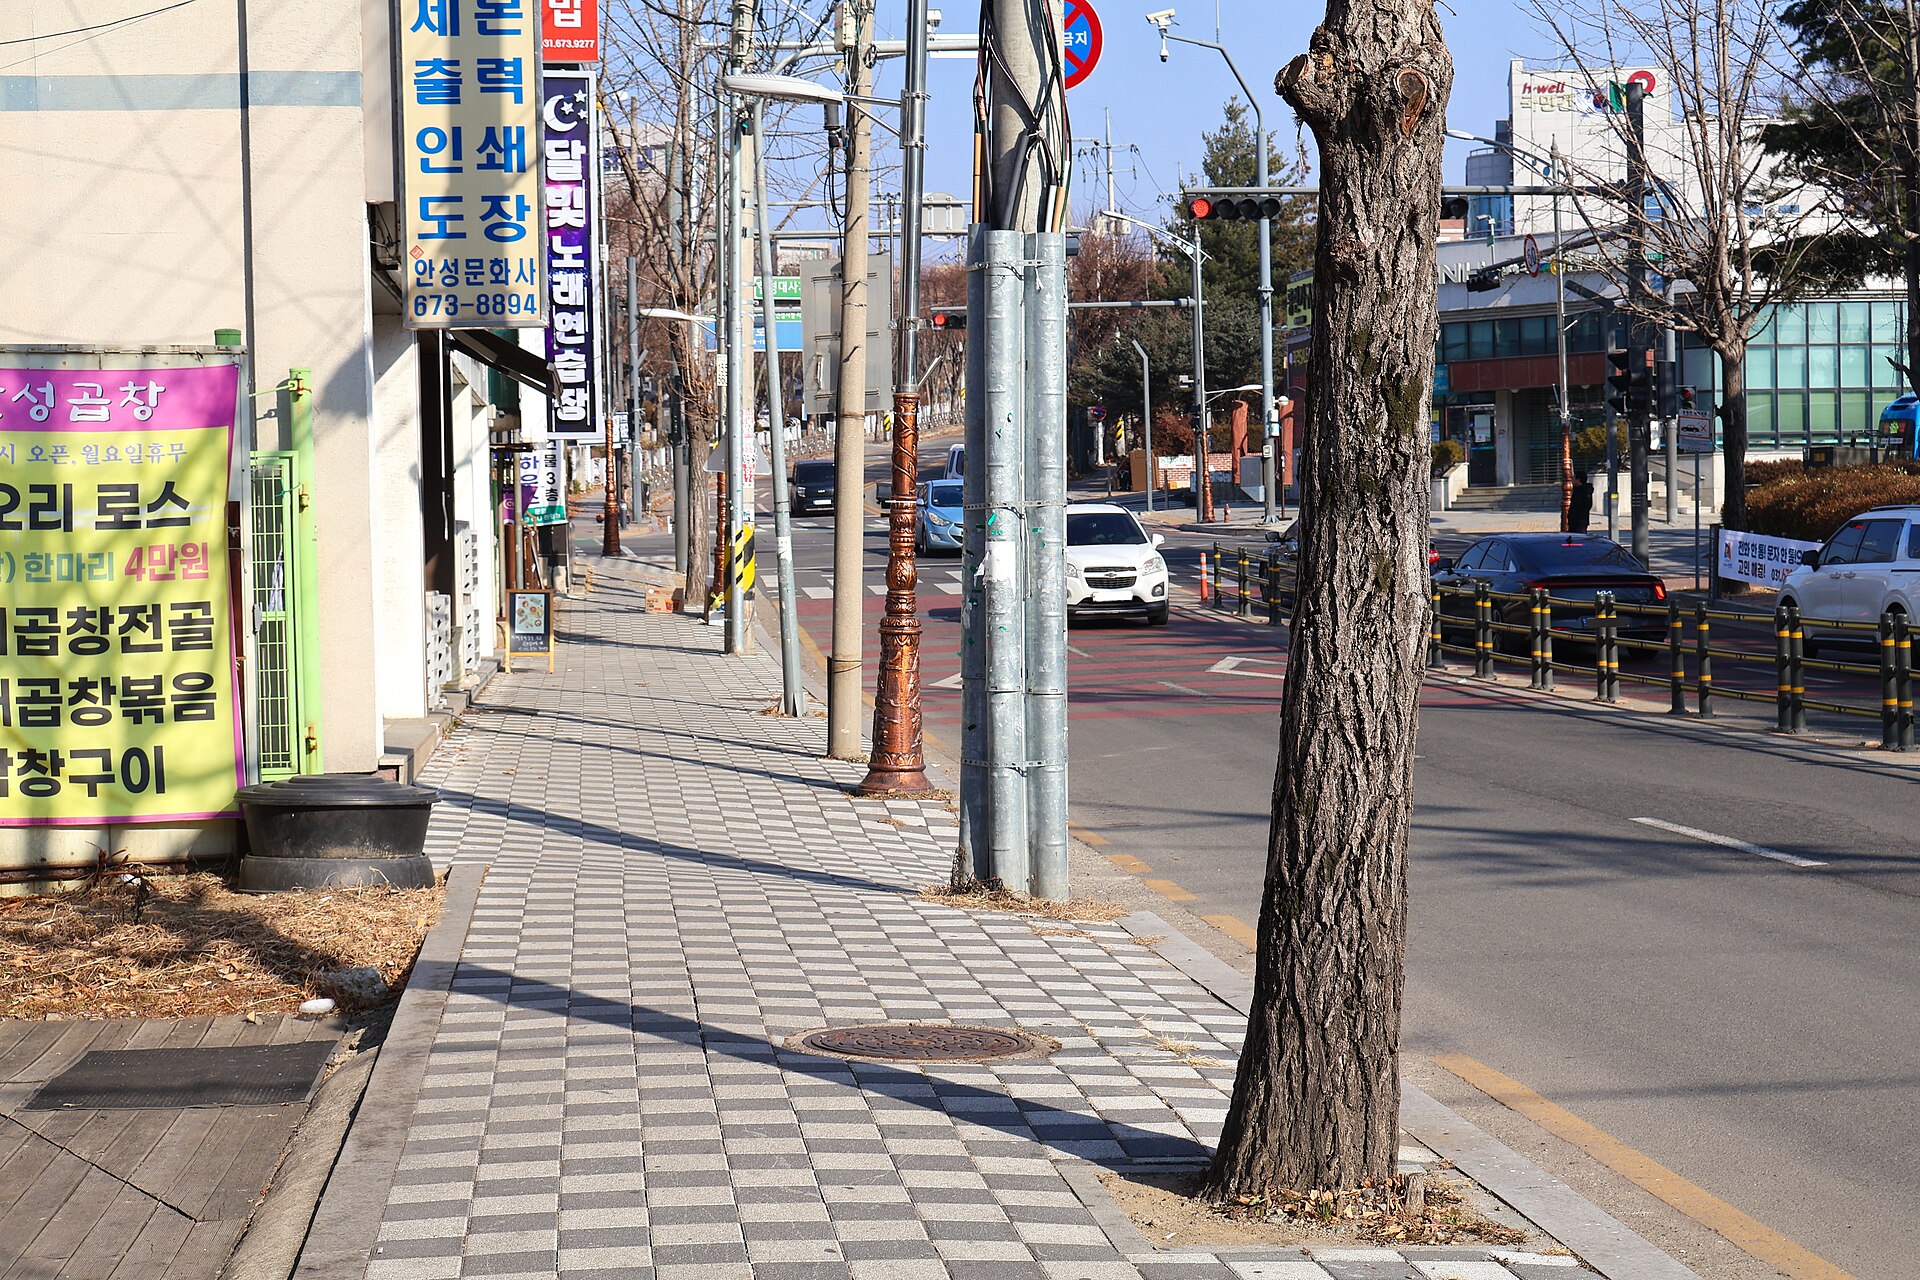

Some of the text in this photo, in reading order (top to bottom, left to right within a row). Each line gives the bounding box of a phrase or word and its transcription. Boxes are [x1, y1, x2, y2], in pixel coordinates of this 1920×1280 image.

[542, 38, 595, 49] 31.673.9277
[413, 57, 524, 105] 출력
[415, 125, 527, 174] 인쇄
[416, 194, 532, 243] 도장
[414, 257, 537, 288] 안성문화사
[544, 139, 588, 423] 달빛노래연습장
[413, 293, 537, 317] 673-8894
[0, 379, 166, 423] 성곱창
[94, 480, 191, 532] 로스
[23, 551, 116, 583] 한마리
[124, 541, 210, 582] 4만원
[0, 600, 215, 657] 곱창전골
[0, 670, 217, 727] 곱창볶음
[0, 745, 167, 798] 창구이
